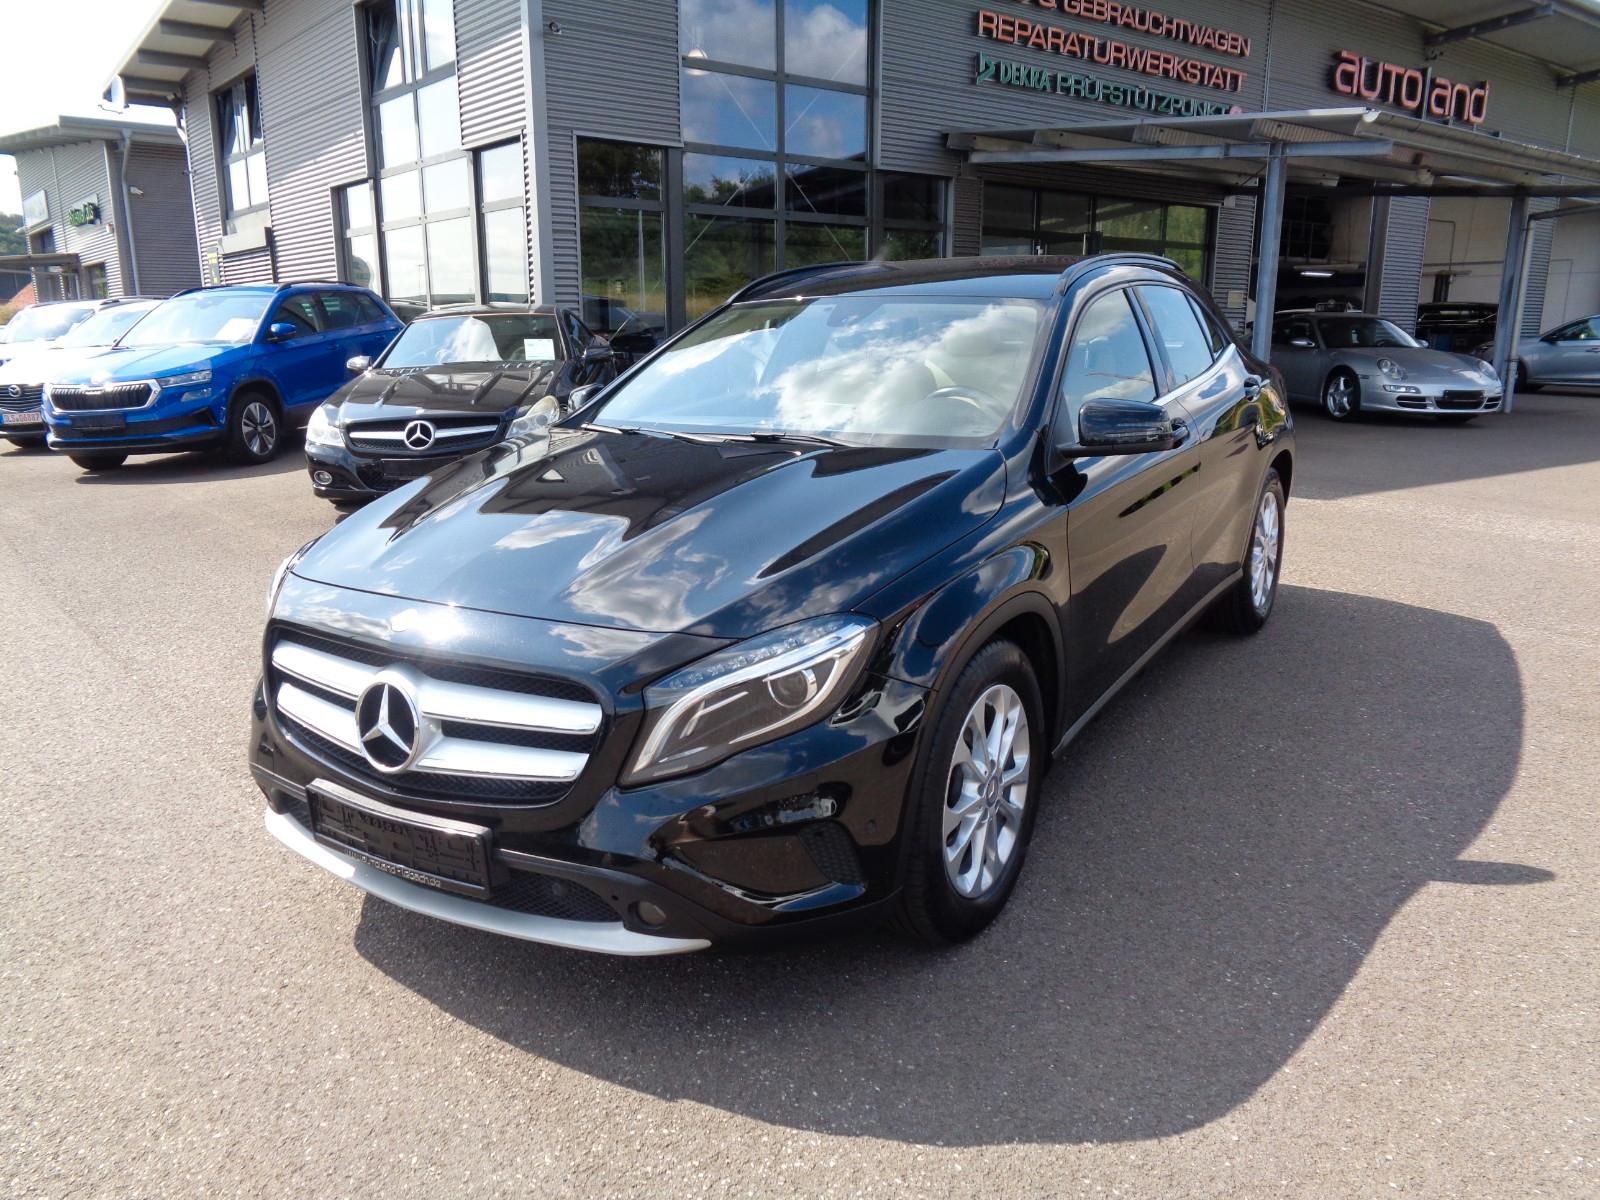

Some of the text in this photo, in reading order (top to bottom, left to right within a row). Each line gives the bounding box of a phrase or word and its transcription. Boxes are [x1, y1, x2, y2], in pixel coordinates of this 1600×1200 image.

[978, 10, 1248, 92] REPARATURWERKSTATT
[1063, 0, 1251, 57] GEBRAUCHTWAGEN
[1000, 60, 1051, 92] DEKRA
